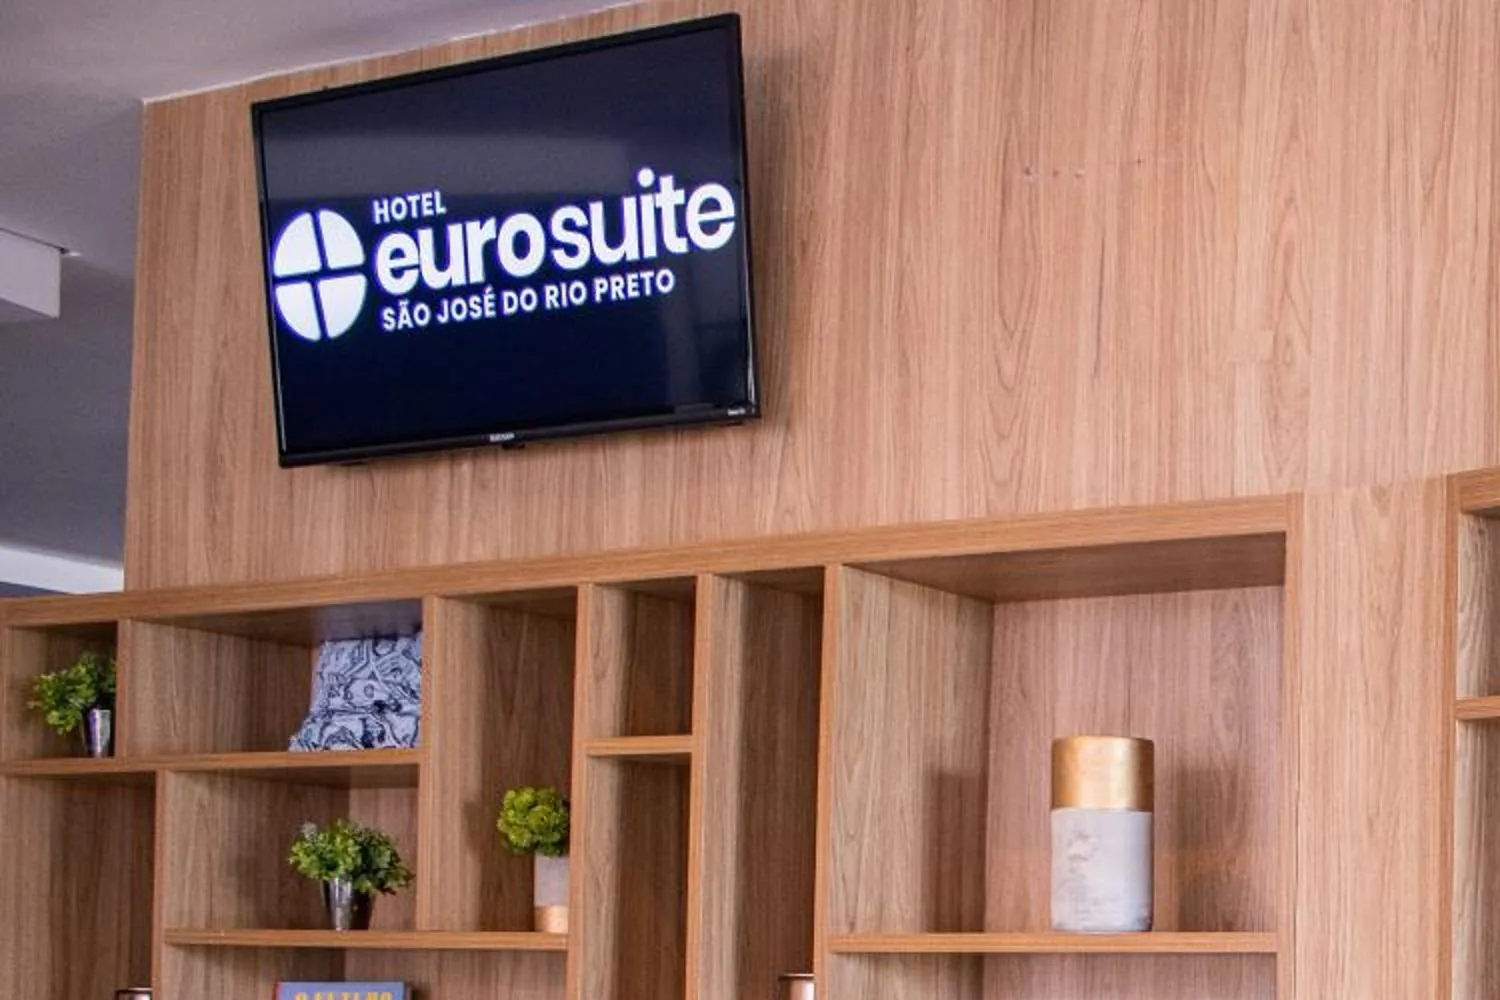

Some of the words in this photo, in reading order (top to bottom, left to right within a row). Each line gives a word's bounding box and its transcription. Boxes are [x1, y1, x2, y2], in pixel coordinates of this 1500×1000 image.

[373, 191, 447, 225] HOTEL
[375, 167, 735, 295] eurosuite
[382, 299, 430, 331] SÃO
[437, 286, 496, 322] JOSÉ
[502, 289, 538, 316] DO
[544, 280, 587, 310] RIO
[594, 269, 675, 304] PRETO
